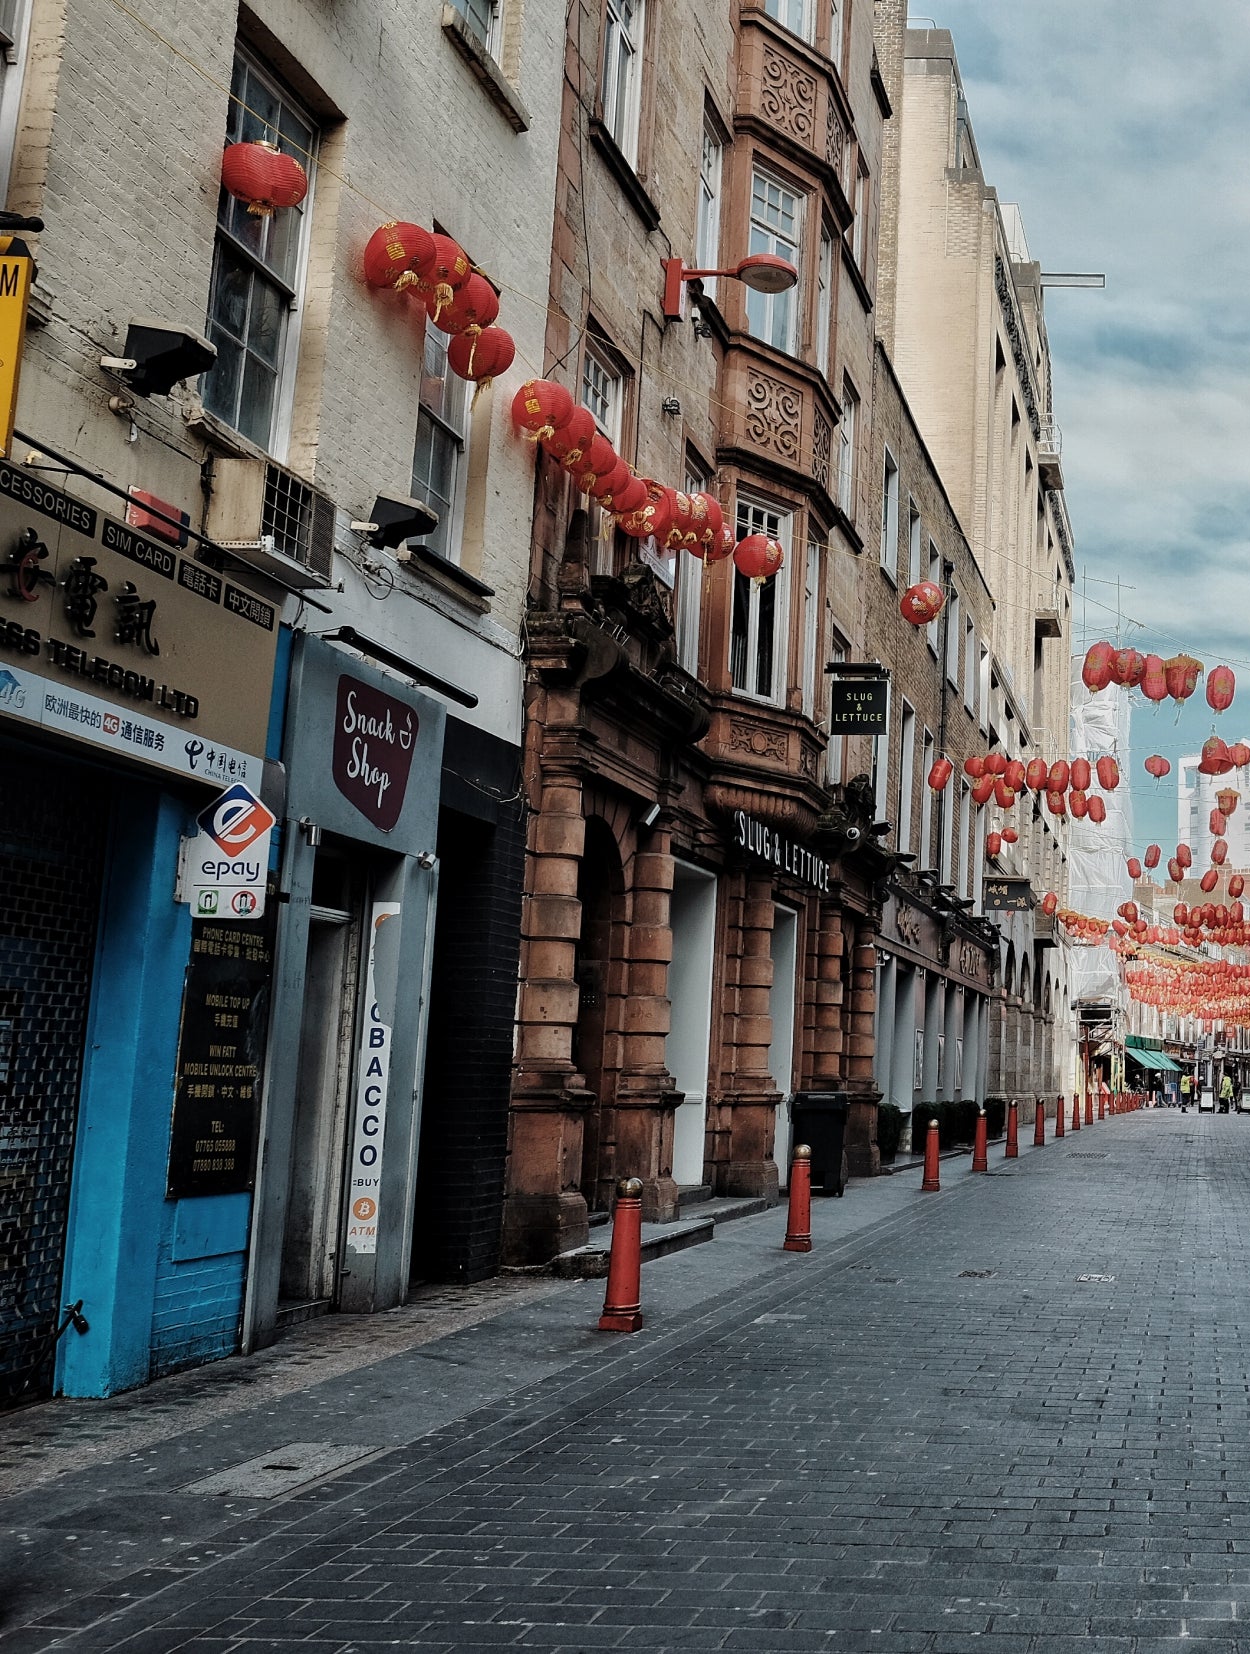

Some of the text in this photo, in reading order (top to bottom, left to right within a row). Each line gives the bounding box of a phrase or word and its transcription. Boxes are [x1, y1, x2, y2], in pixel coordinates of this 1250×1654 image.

[106, 526, 172, 572] SIM CARD
[183, 564, 219, 598] 電話卡
[229, 590, 272, 628] 中文開鎖
[47, 637, 155, 701] TELECOM
[156, 684, 199, 718] LTD
[846, 692, 873, 701] SLUG
[856, 703, 862, 711] &
[343, 691, 395, 744] Snack
[835, 713, 883, 722] LETTUCE
[121, 720, 165, 751] 通信服务
[204, 768, 221, 779] CHINA
[347, 737, 391, 808] Shop
[739, 810, 830, 893] SLUG & LETTUCE
[201, 860, 260, 882] epay
[202, 926, 265, 948] PHONE CARD CENTRE
[205, 993, 251, 1009] MOBILE TOP UP
[208, 1044, 238, 1058] WIN FATT
[184, 1062, 257, 1078] MOBILE UNLOCK CENTRE
[210, 1120, 225, 1133] TEL:
[349, 1226, 377, 1236] ATM
